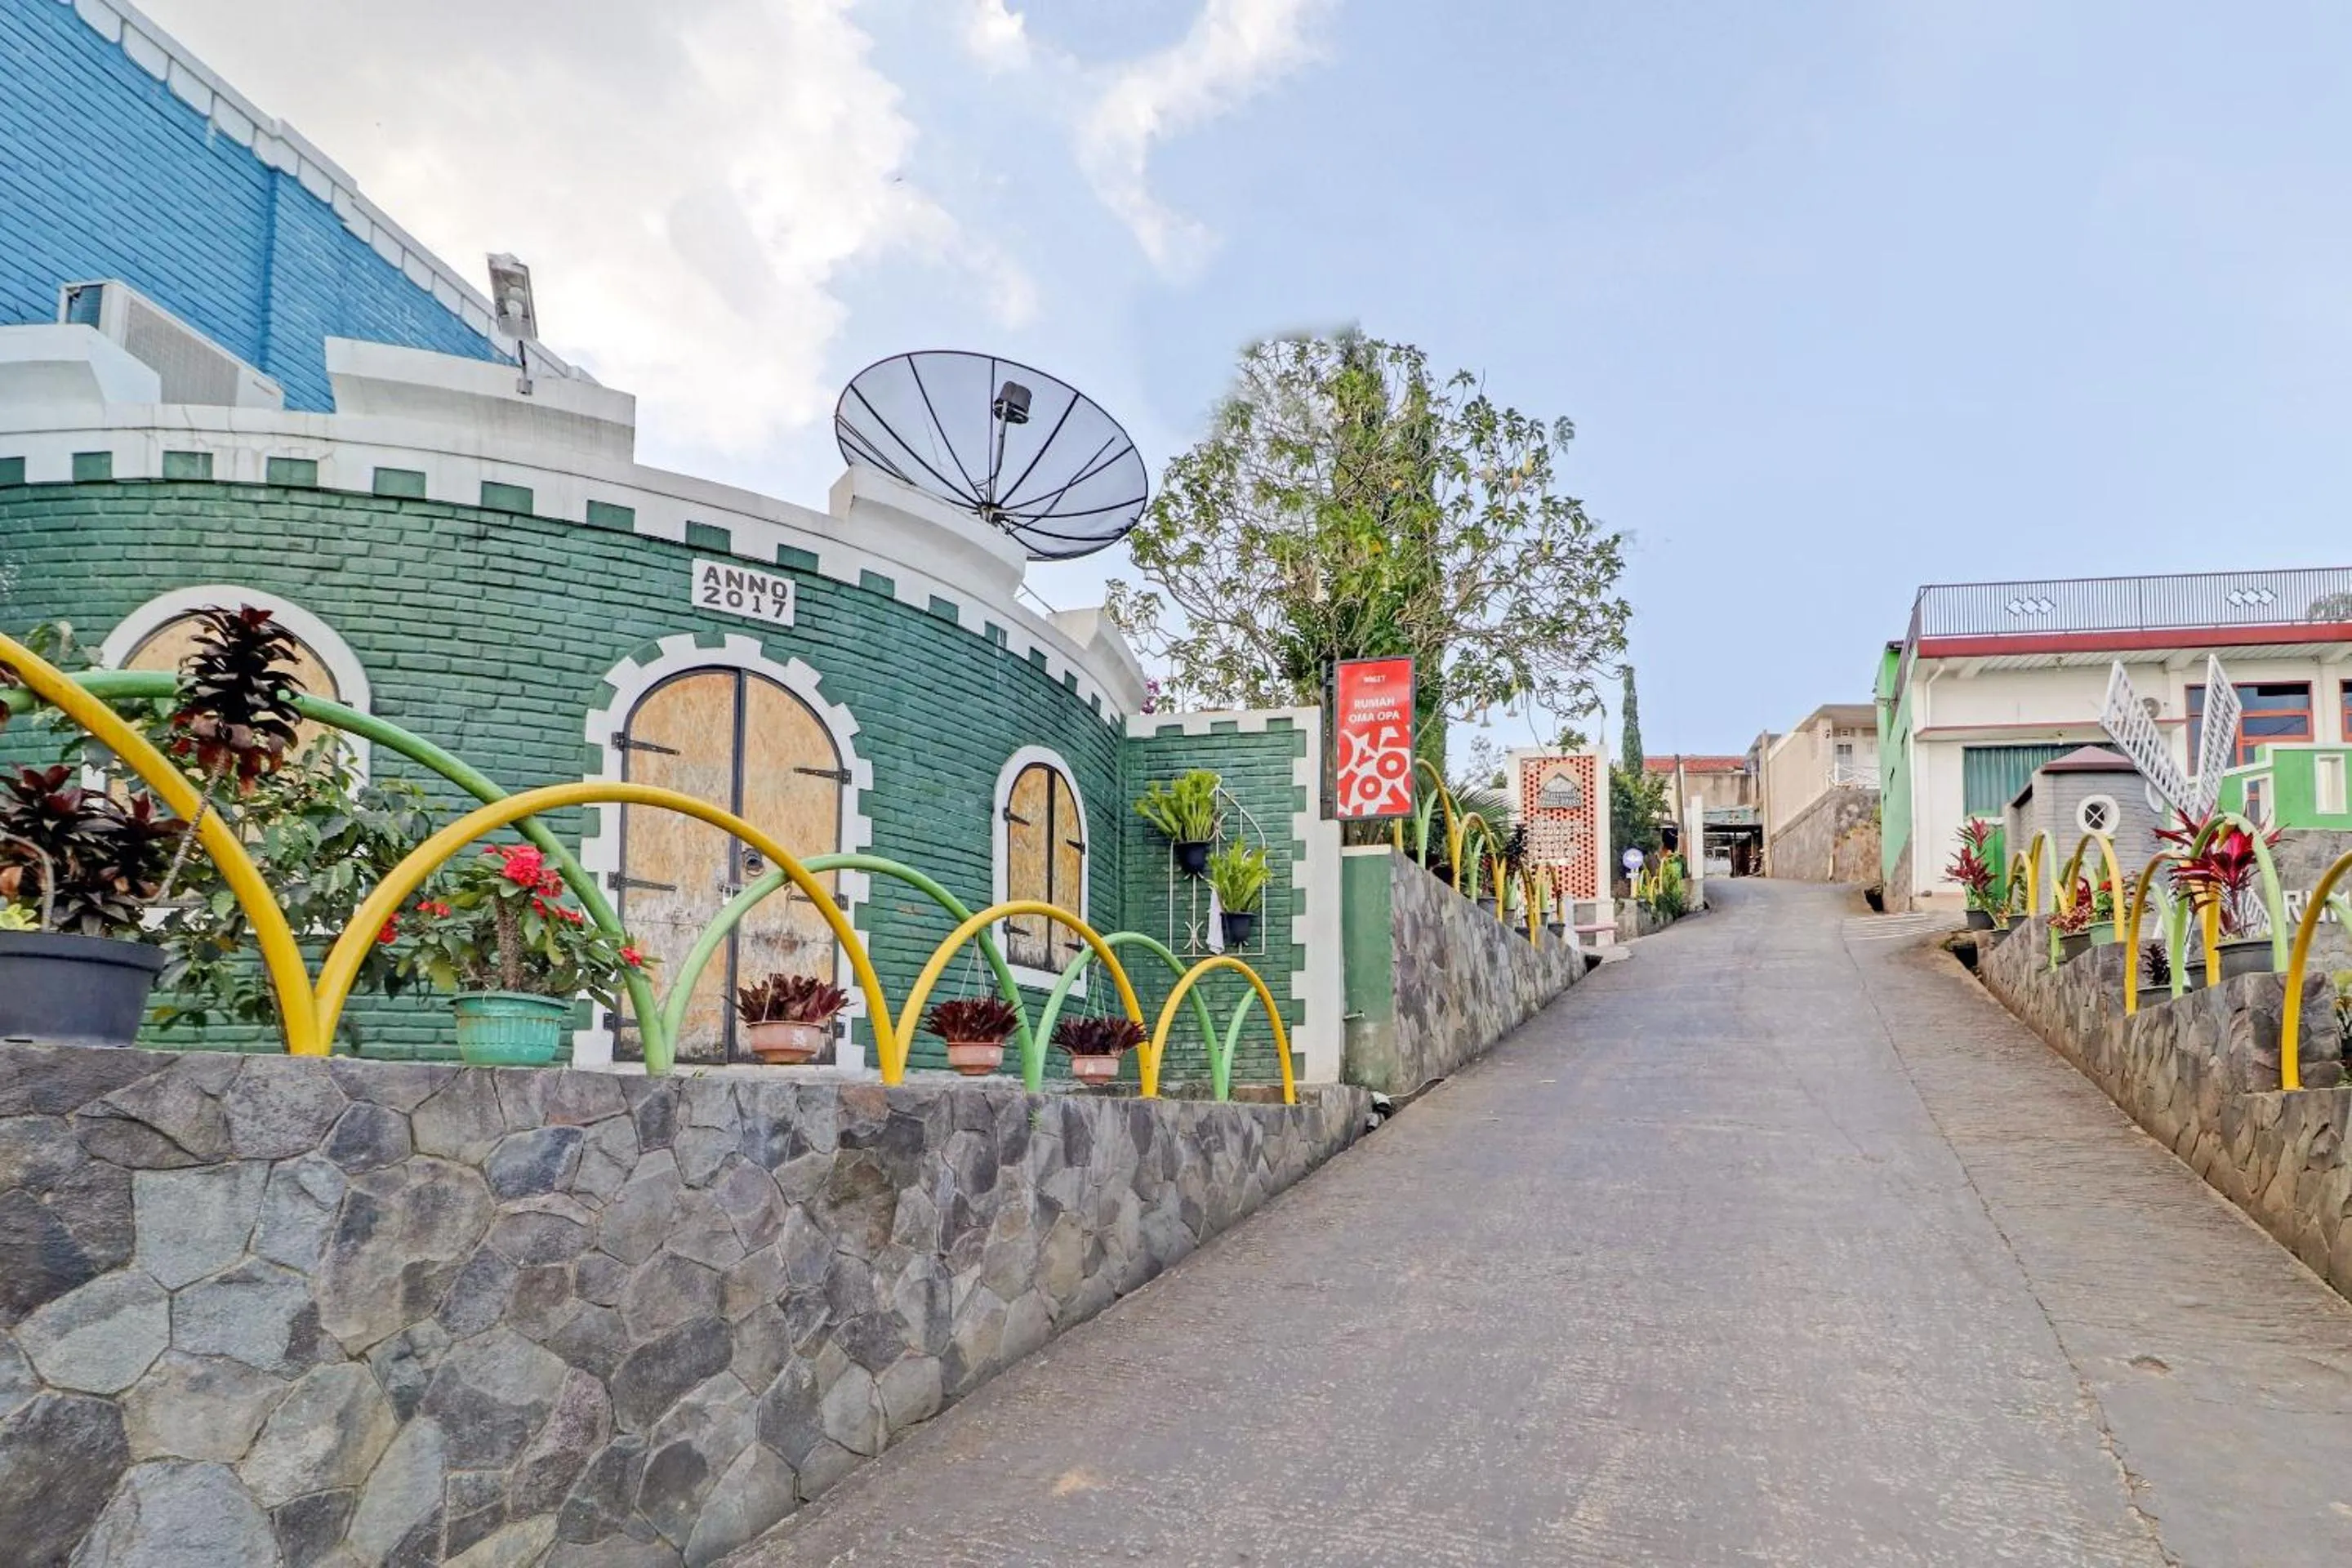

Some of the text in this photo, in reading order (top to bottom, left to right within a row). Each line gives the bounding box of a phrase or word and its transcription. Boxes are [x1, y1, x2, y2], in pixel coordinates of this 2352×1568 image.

[702, 566, 788, 599] ANNO
[702, 586, 786, 618] 2017
[1354, 697, 1395, 710] RUMAH
[1348, 710, 1400, 724] OMA OPA
